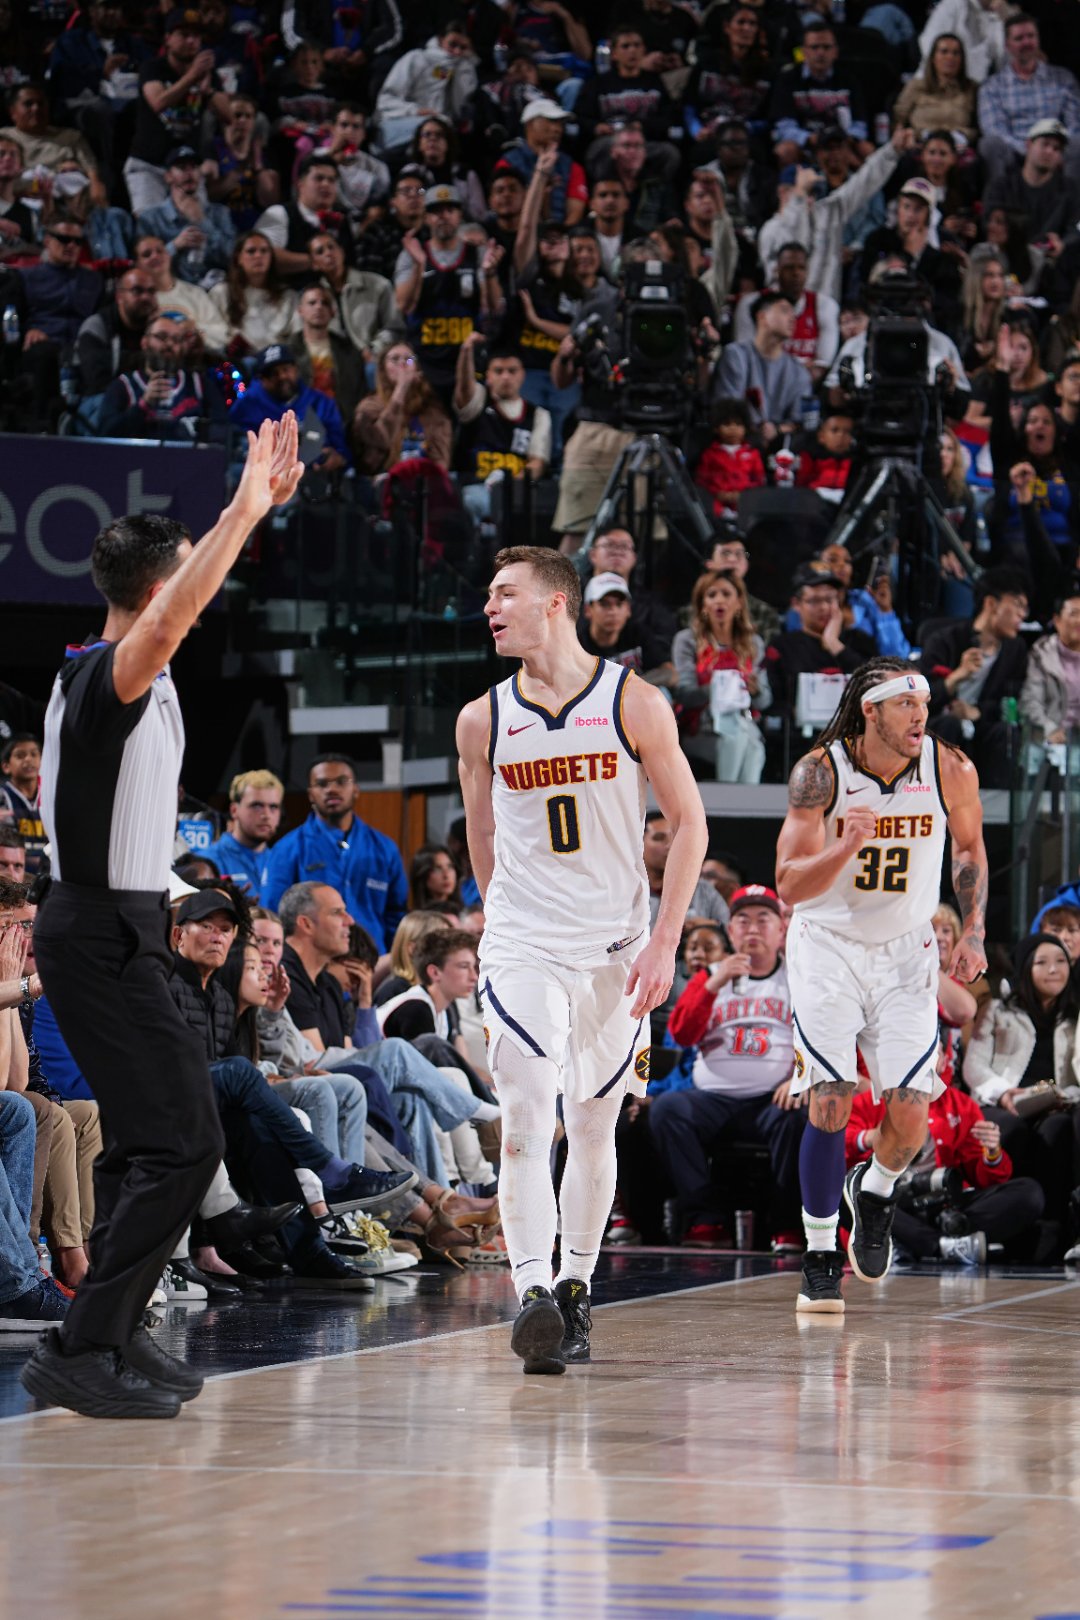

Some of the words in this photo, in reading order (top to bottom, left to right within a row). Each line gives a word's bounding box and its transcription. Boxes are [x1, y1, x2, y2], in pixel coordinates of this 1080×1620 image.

[476, 451, 526, 479] 52
[575, 716, 609, 727] ibotta
[498, 752, 618, 791] NUGGETS
[903, 784, 931, 793] ibotta
[546, 794, 581, 854] 0
[836, 814, 933, 840] GETS
[185, 831, 210, 849] 30
[854, 845, 910, 893] 32
